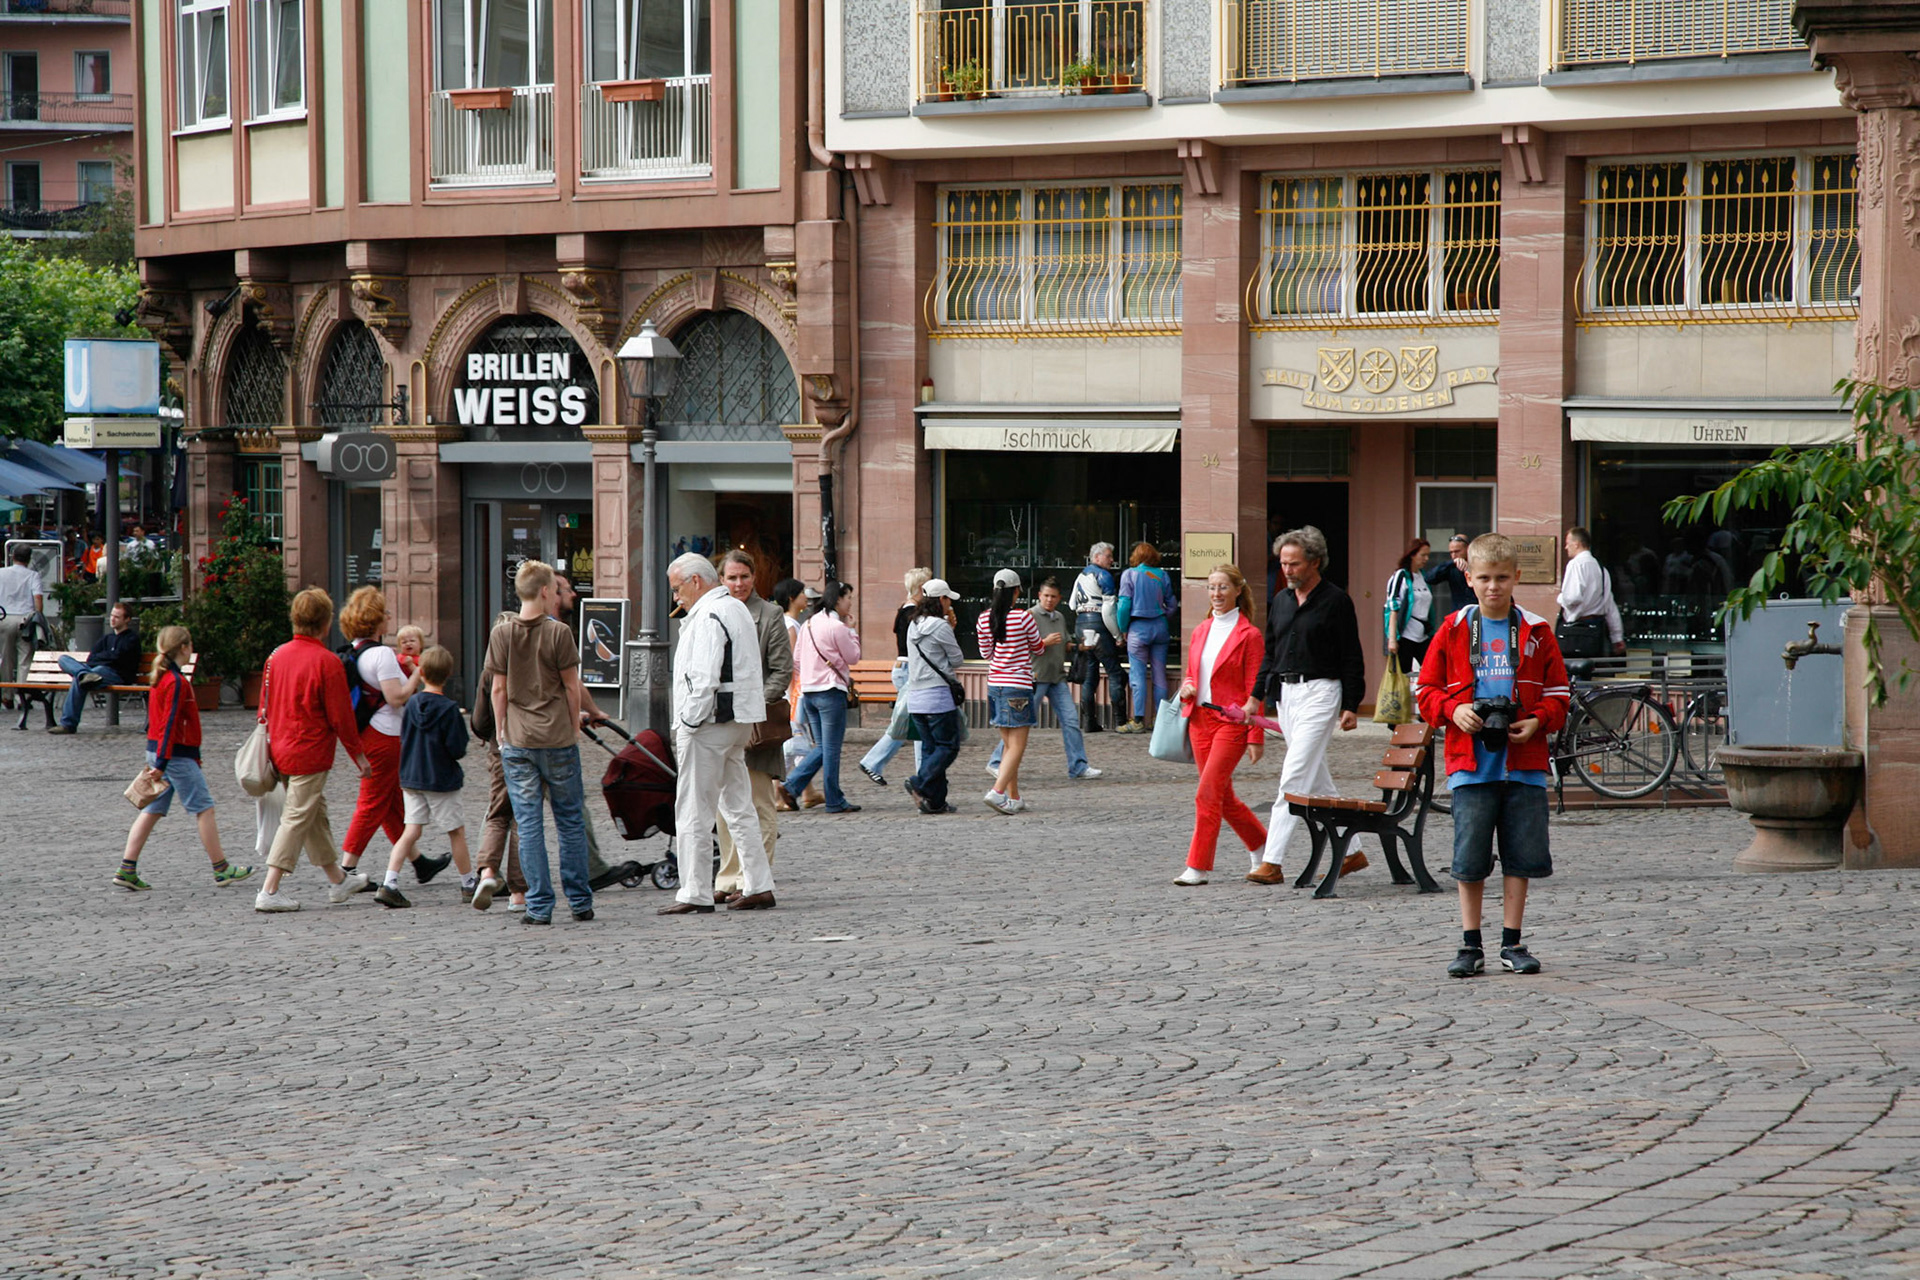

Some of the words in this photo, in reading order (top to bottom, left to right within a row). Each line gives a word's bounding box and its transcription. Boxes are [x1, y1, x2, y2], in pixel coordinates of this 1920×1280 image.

[468, 352, 571, 380] BRILLEN
[1264, 368, 1310, 388] HAUS
[1446, 366, 1488, 386] RAD
[66, 348, 88, 408] U
[454, 386, 587, 425] WEISS
[1304, 391, 1344, 410] ZUM
[1350, 387, 1450, 412] GOLDENEN
[106, 430, 156, 438] Sachsenhausen
[1003, 428, 1093, 449] !schmuck
[1201, 453, 1220, 468] 34
[1520, 454, 1541, 469] 34
